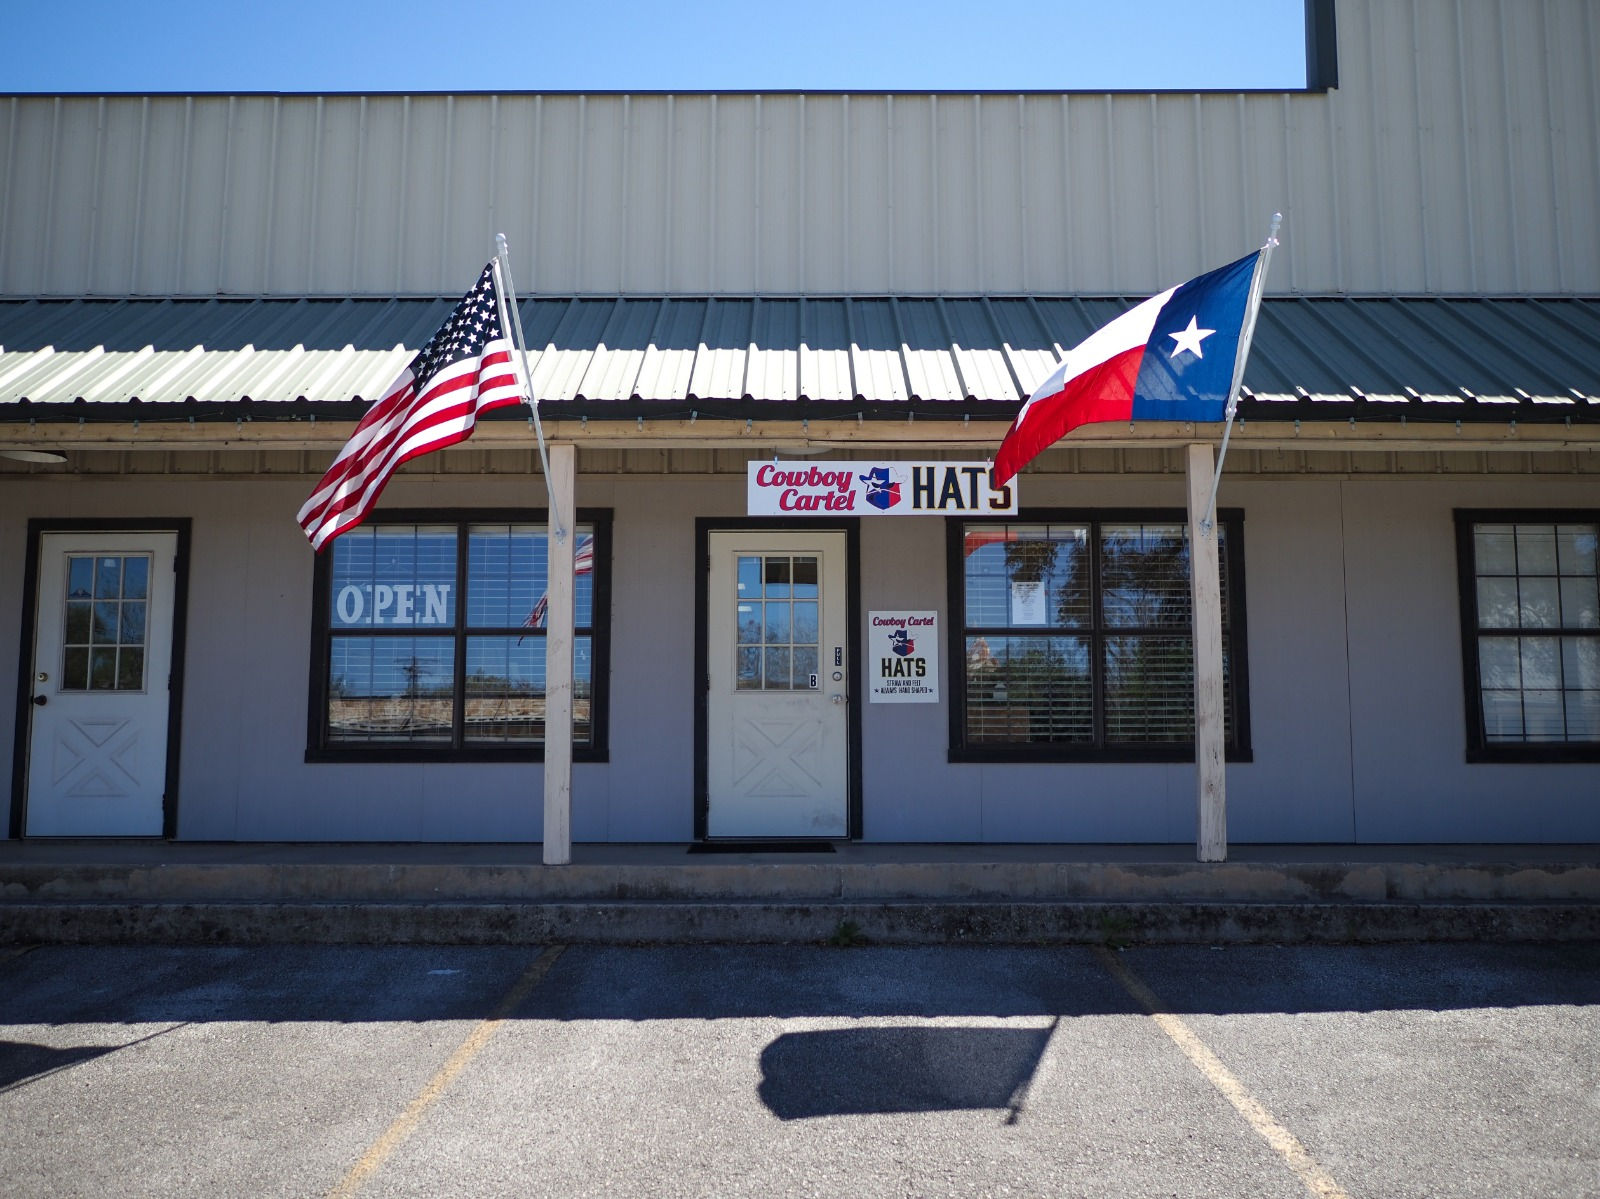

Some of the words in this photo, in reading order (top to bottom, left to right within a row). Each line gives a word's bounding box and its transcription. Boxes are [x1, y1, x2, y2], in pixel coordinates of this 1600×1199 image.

[756, 464, 853, 493] Cowboy
[911, 466, 1011, 510] HATS
[779, 487, 857, 511] Cartel
[336, 584, 451, 624] OPEN
[872, 616, 906, 628] Cowboy
[907, 616, 934, 626] Cartel
[881, 657, 926, 677] HATS
[810, 674, 817, 687] B
[898, 686, 911, 694] HAND
[911, 686, 928, 694] SHAPED
[902, 679, 911, 687] AND
